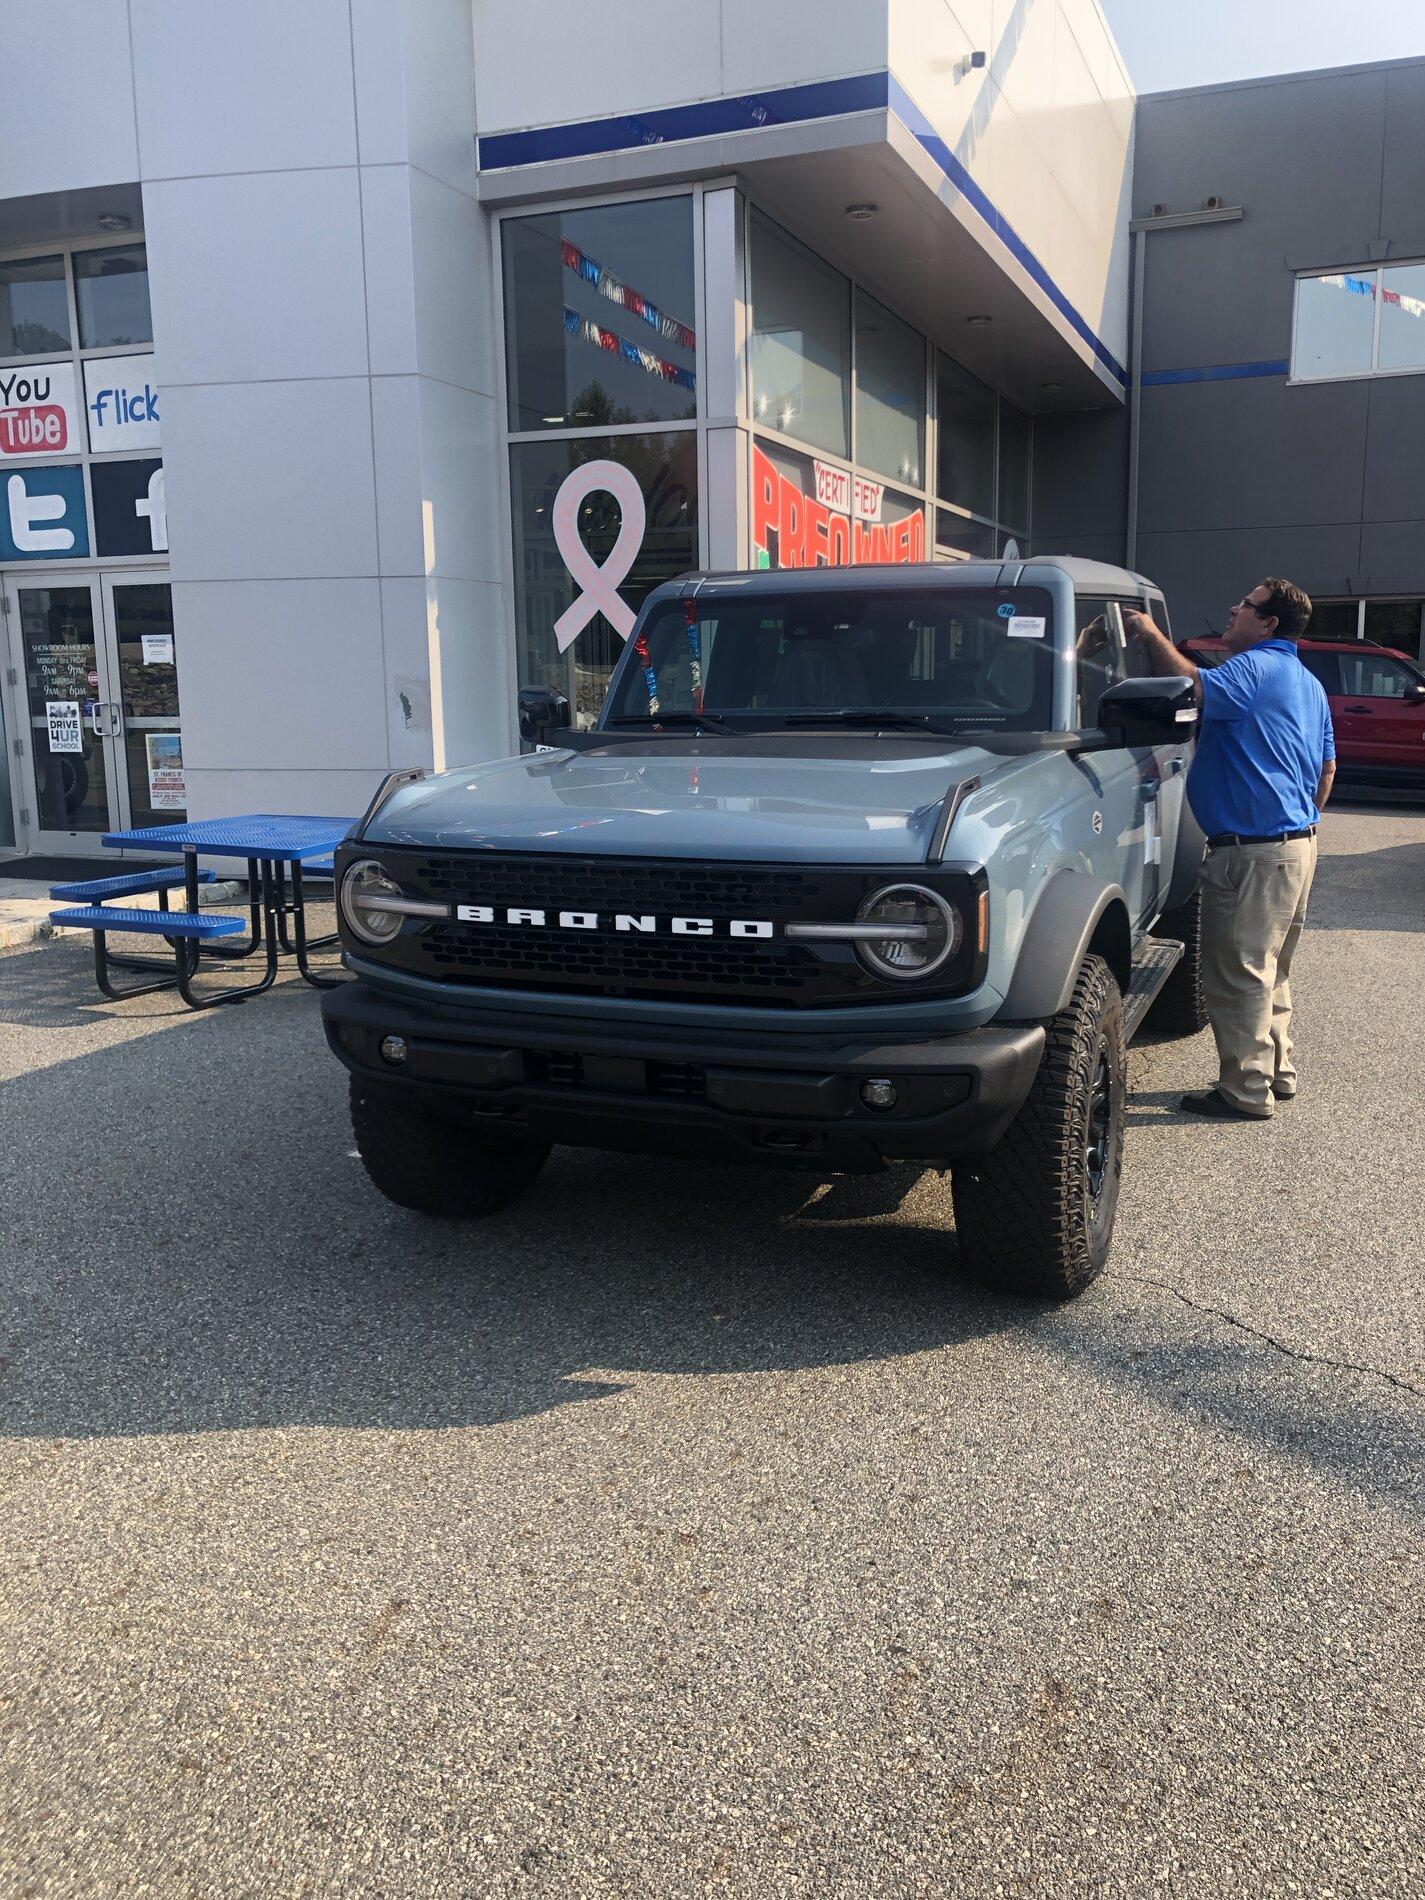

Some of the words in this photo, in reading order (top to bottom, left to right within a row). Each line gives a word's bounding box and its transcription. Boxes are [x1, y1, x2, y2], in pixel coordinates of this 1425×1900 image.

[0, 373, 51, 406] You
[0, 408, 62, 446] Tube
[50, 720, 78, 729] DRIVE
[51, 729, 79, 742] 4UR
[456, 904, 773, 938] BRONCO
